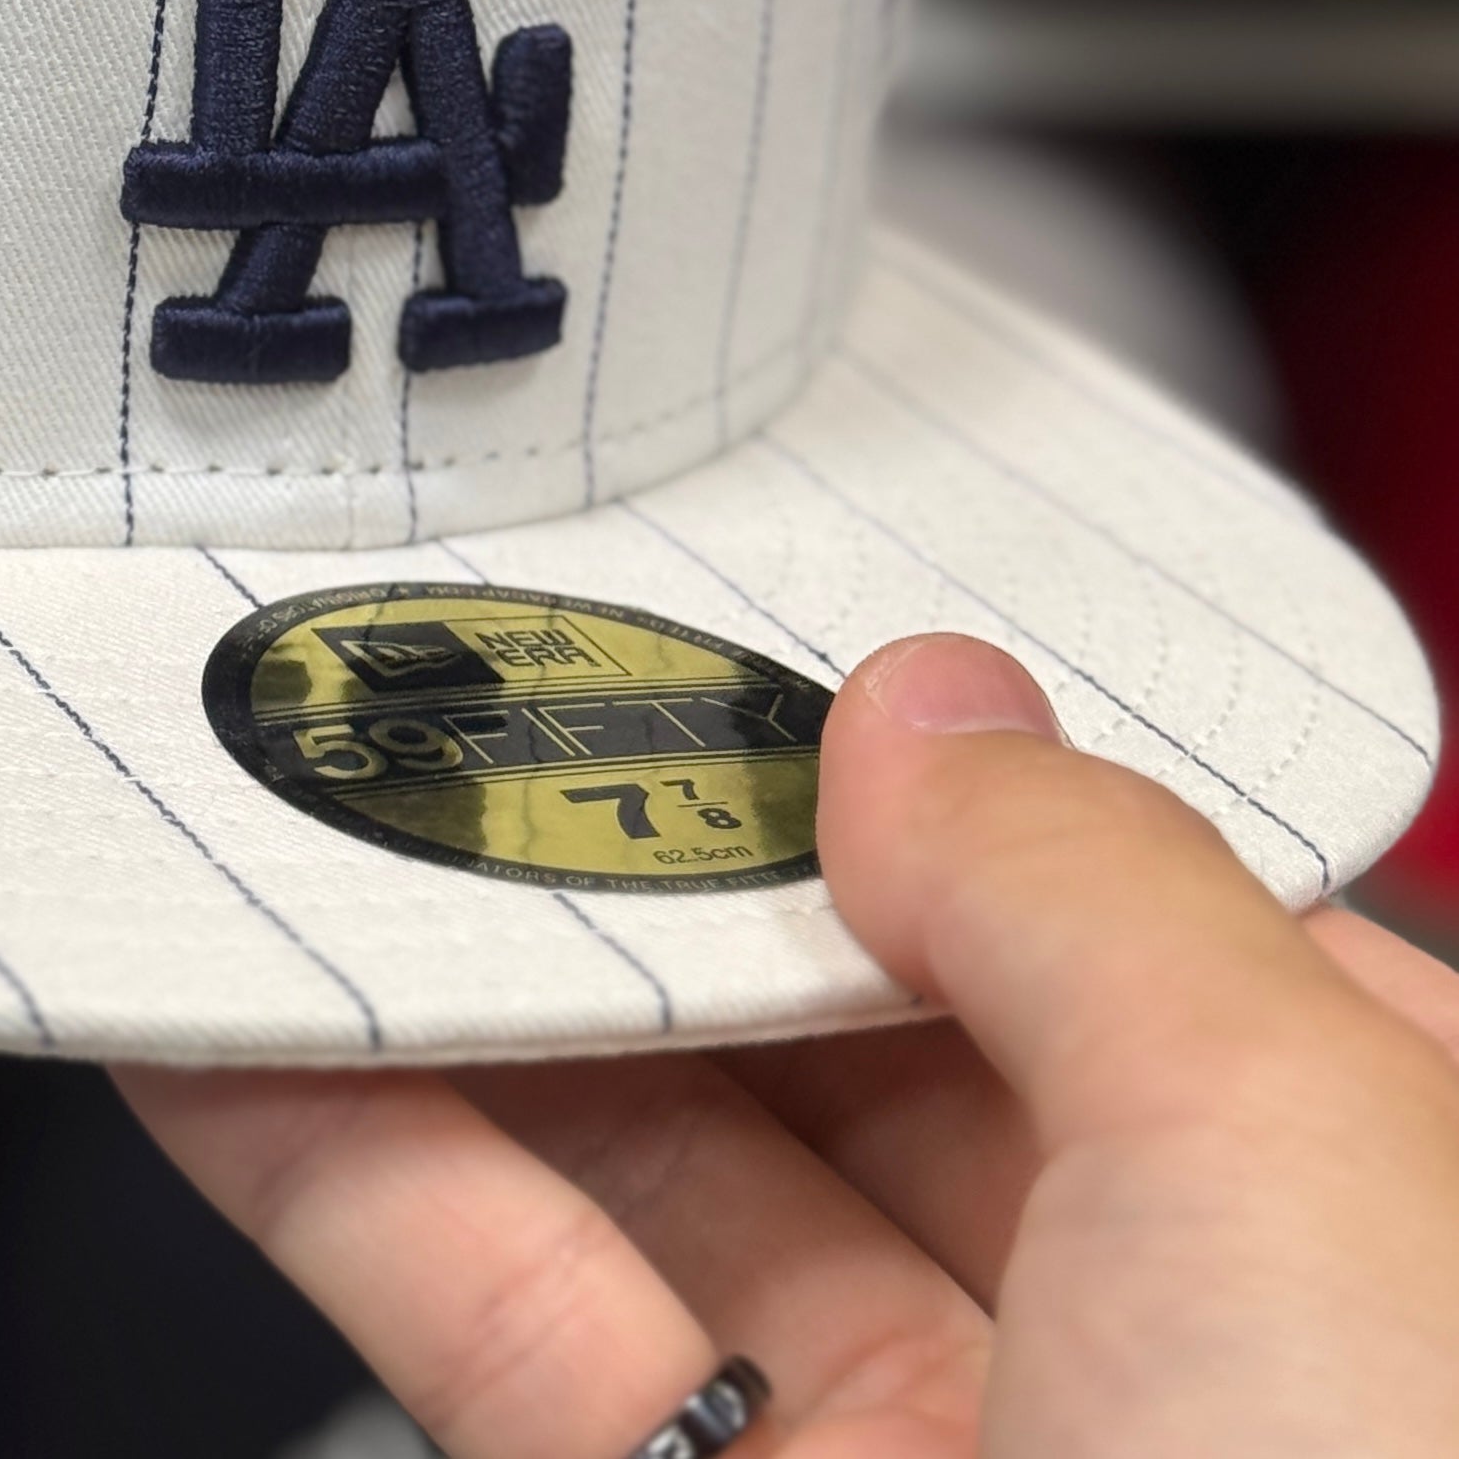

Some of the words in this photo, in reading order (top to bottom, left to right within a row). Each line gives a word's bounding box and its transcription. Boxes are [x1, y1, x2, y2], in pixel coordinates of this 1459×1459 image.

[474, 629, 570, 650] NEW
[495, 647, 601, 669] ERA
[293, 694, 797, 780] 59FIFTY
[560, 783, 661, 840] 7
[653, 845, 753, 865] 62.5cm
